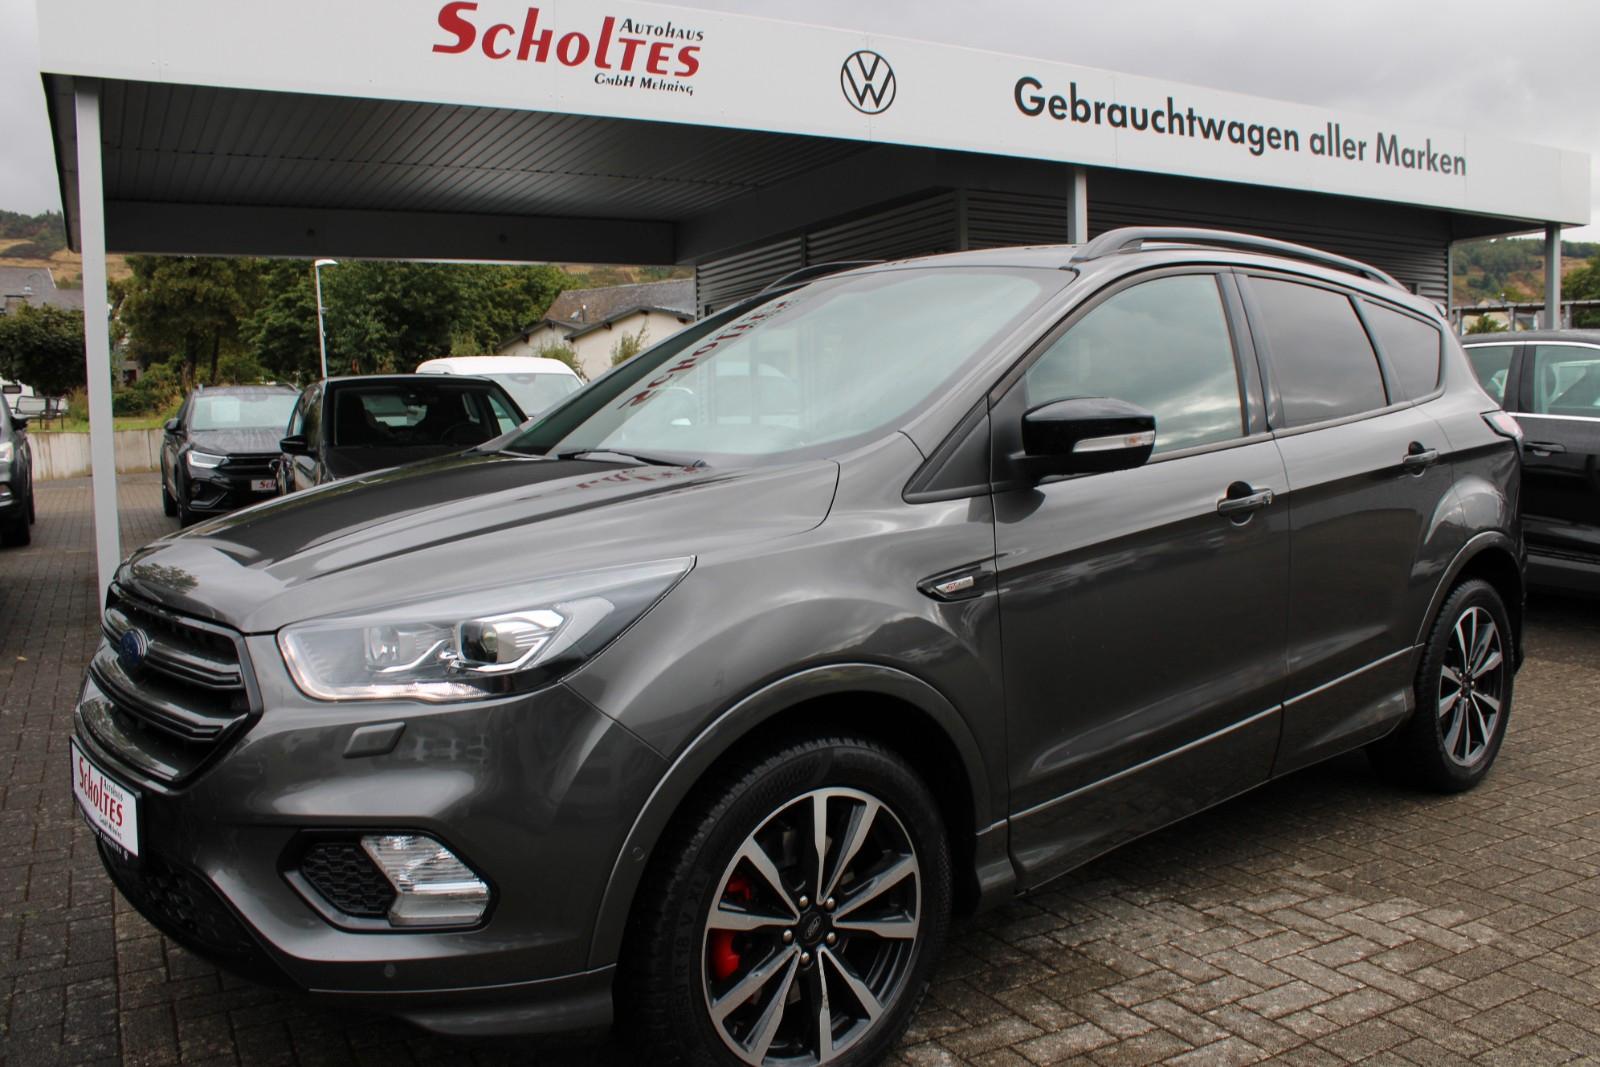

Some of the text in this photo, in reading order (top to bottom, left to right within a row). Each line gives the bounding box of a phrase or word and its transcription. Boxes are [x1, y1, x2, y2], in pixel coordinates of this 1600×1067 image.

[1014, 76, 1466, 176] Gebrauchtwagen aller Marken
